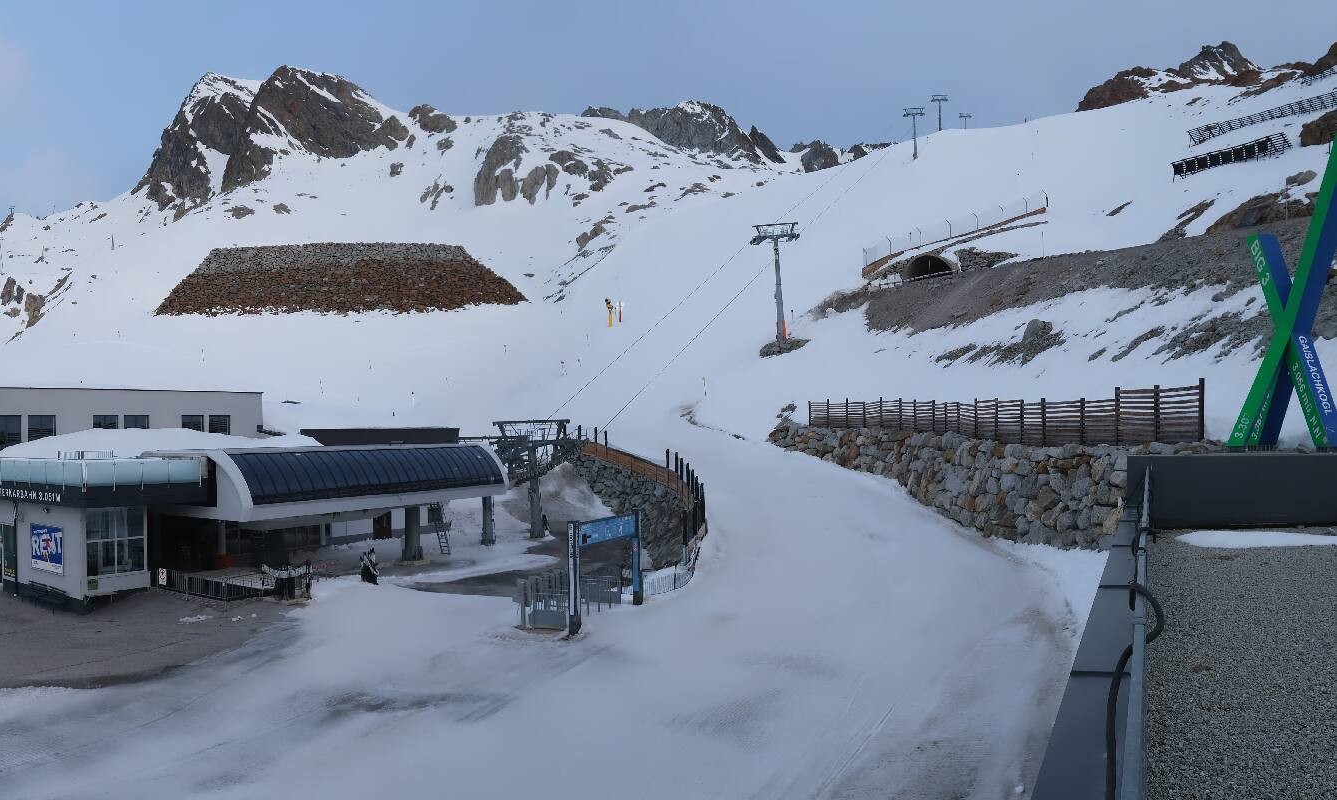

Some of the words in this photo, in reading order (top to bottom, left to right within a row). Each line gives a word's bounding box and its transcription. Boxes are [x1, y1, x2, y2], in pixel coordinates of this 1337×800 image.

[1251, 239, 1266, 272] BIG
[1261, 272, 1270, 286] 3
[1298, 335, 1332, 416] GAISLACHKOGL
